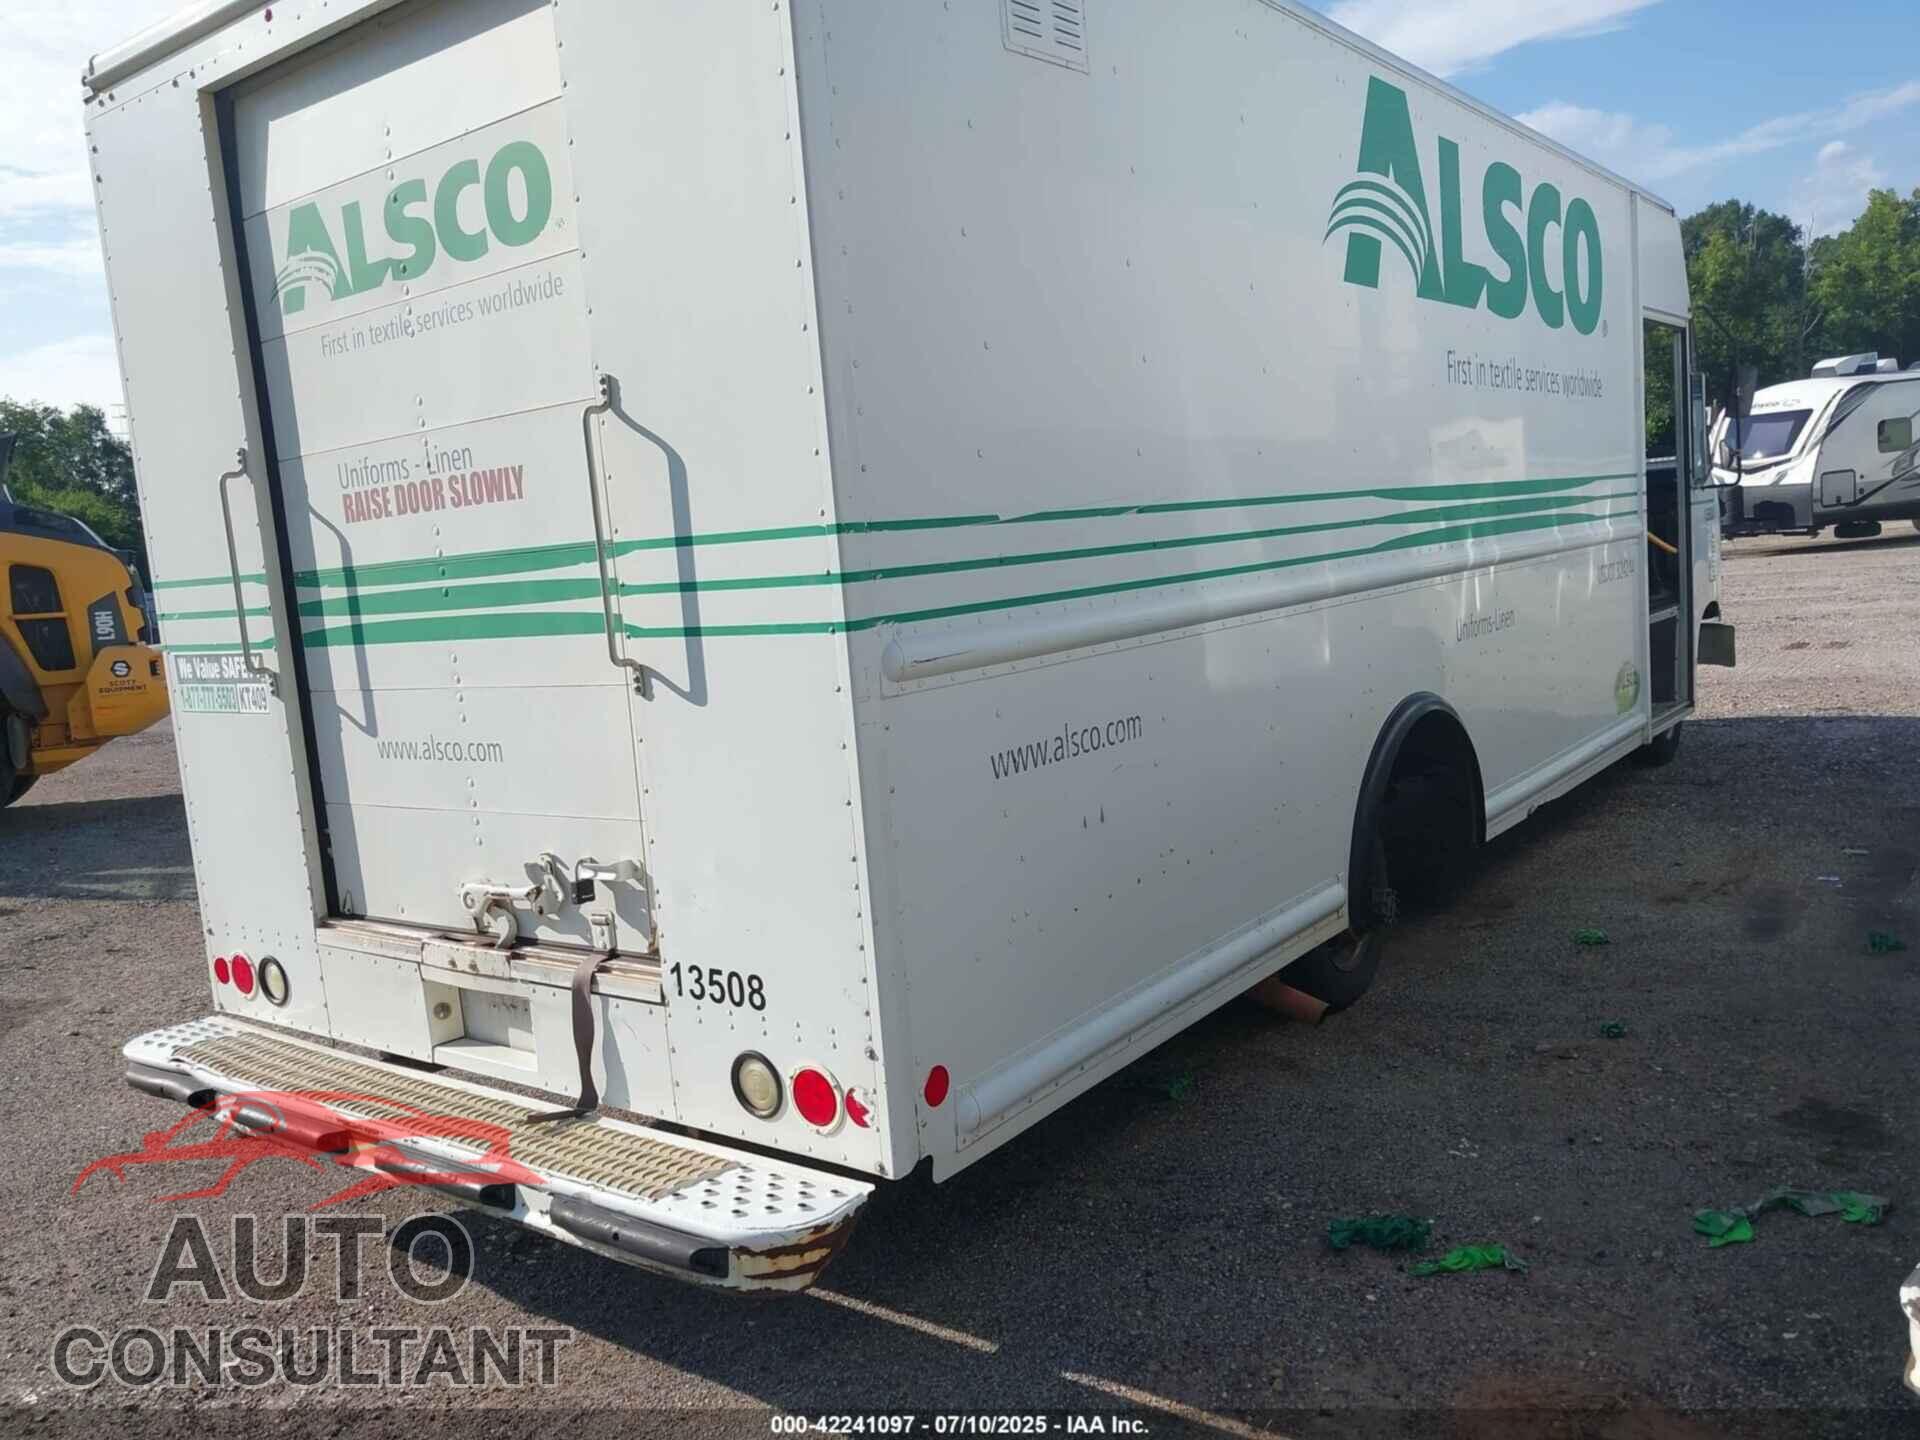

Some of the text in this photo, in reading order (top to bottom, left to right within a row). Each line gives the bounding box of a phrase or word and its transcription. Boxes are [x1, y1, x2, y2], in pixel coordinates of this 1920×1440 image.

[271, 141, 552, 316] ALSCO
[1322, 74, 1602, 335] ALSCO
[321, 271, 564, 359] First in textile services worldwide
[1447, 350, 1603, 398] First in textile services worldwide
[338, 457, 410, 489] Uniforms
[426, 445, 473, 475] Linen
[342, 465, 524, 524] RAISE DOOR SLOWLY
[94, 611, 116, 641] L90H
[177, 655, 261, 679] We Value SAFEY
[377, 734, 503, 762] www.alsco.com
[990, 715, 1143, 780] www.alsco.com
[670, 961, 766, 1011] 13508
